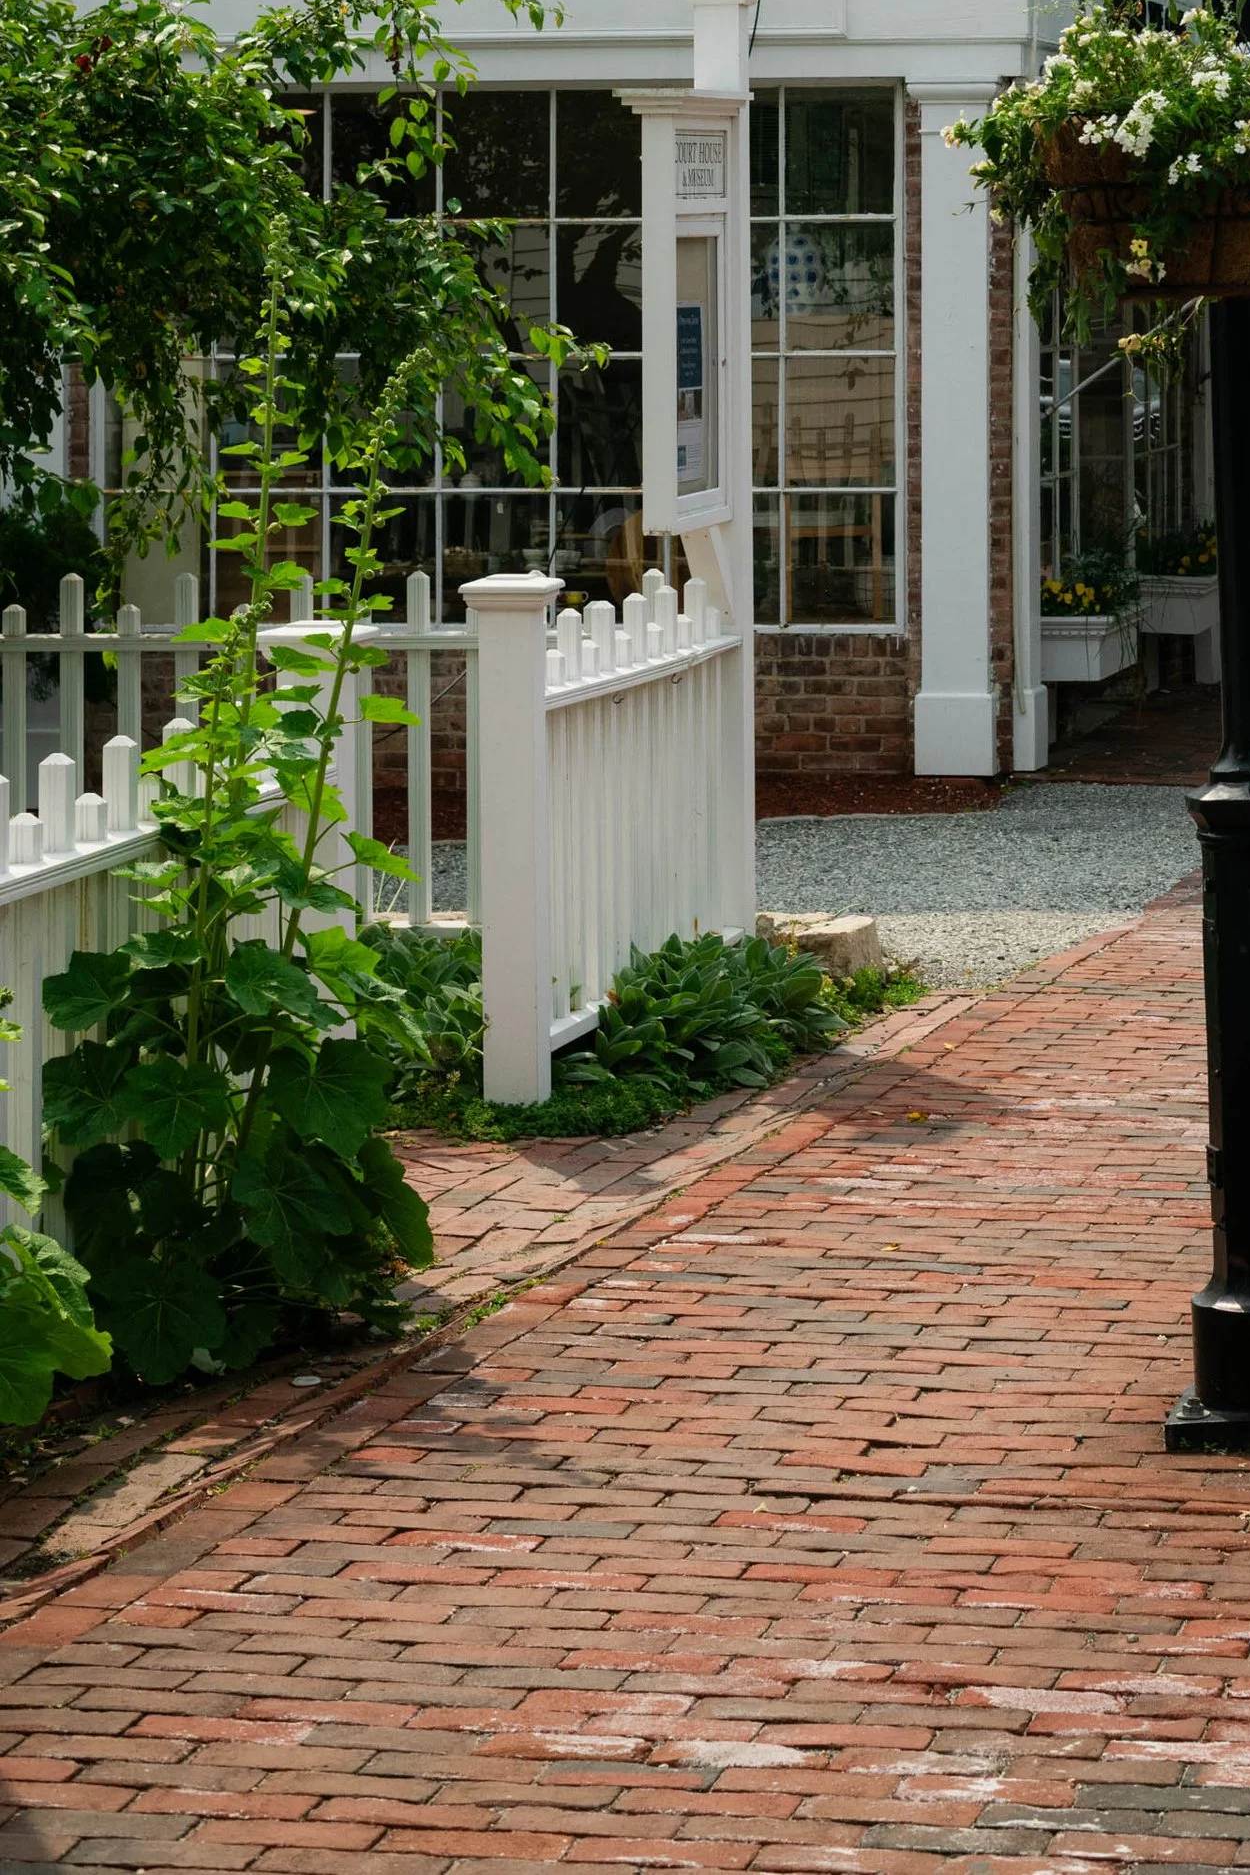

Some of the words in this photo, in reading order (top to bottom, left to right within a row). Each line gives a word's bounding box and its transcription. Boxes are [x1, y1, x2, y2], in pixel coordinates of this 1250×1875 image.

[699, 142, 722, 164] HOUSE
[682, 171, 687, 187] &
[688, 168, 714, 187] MUSEUM
